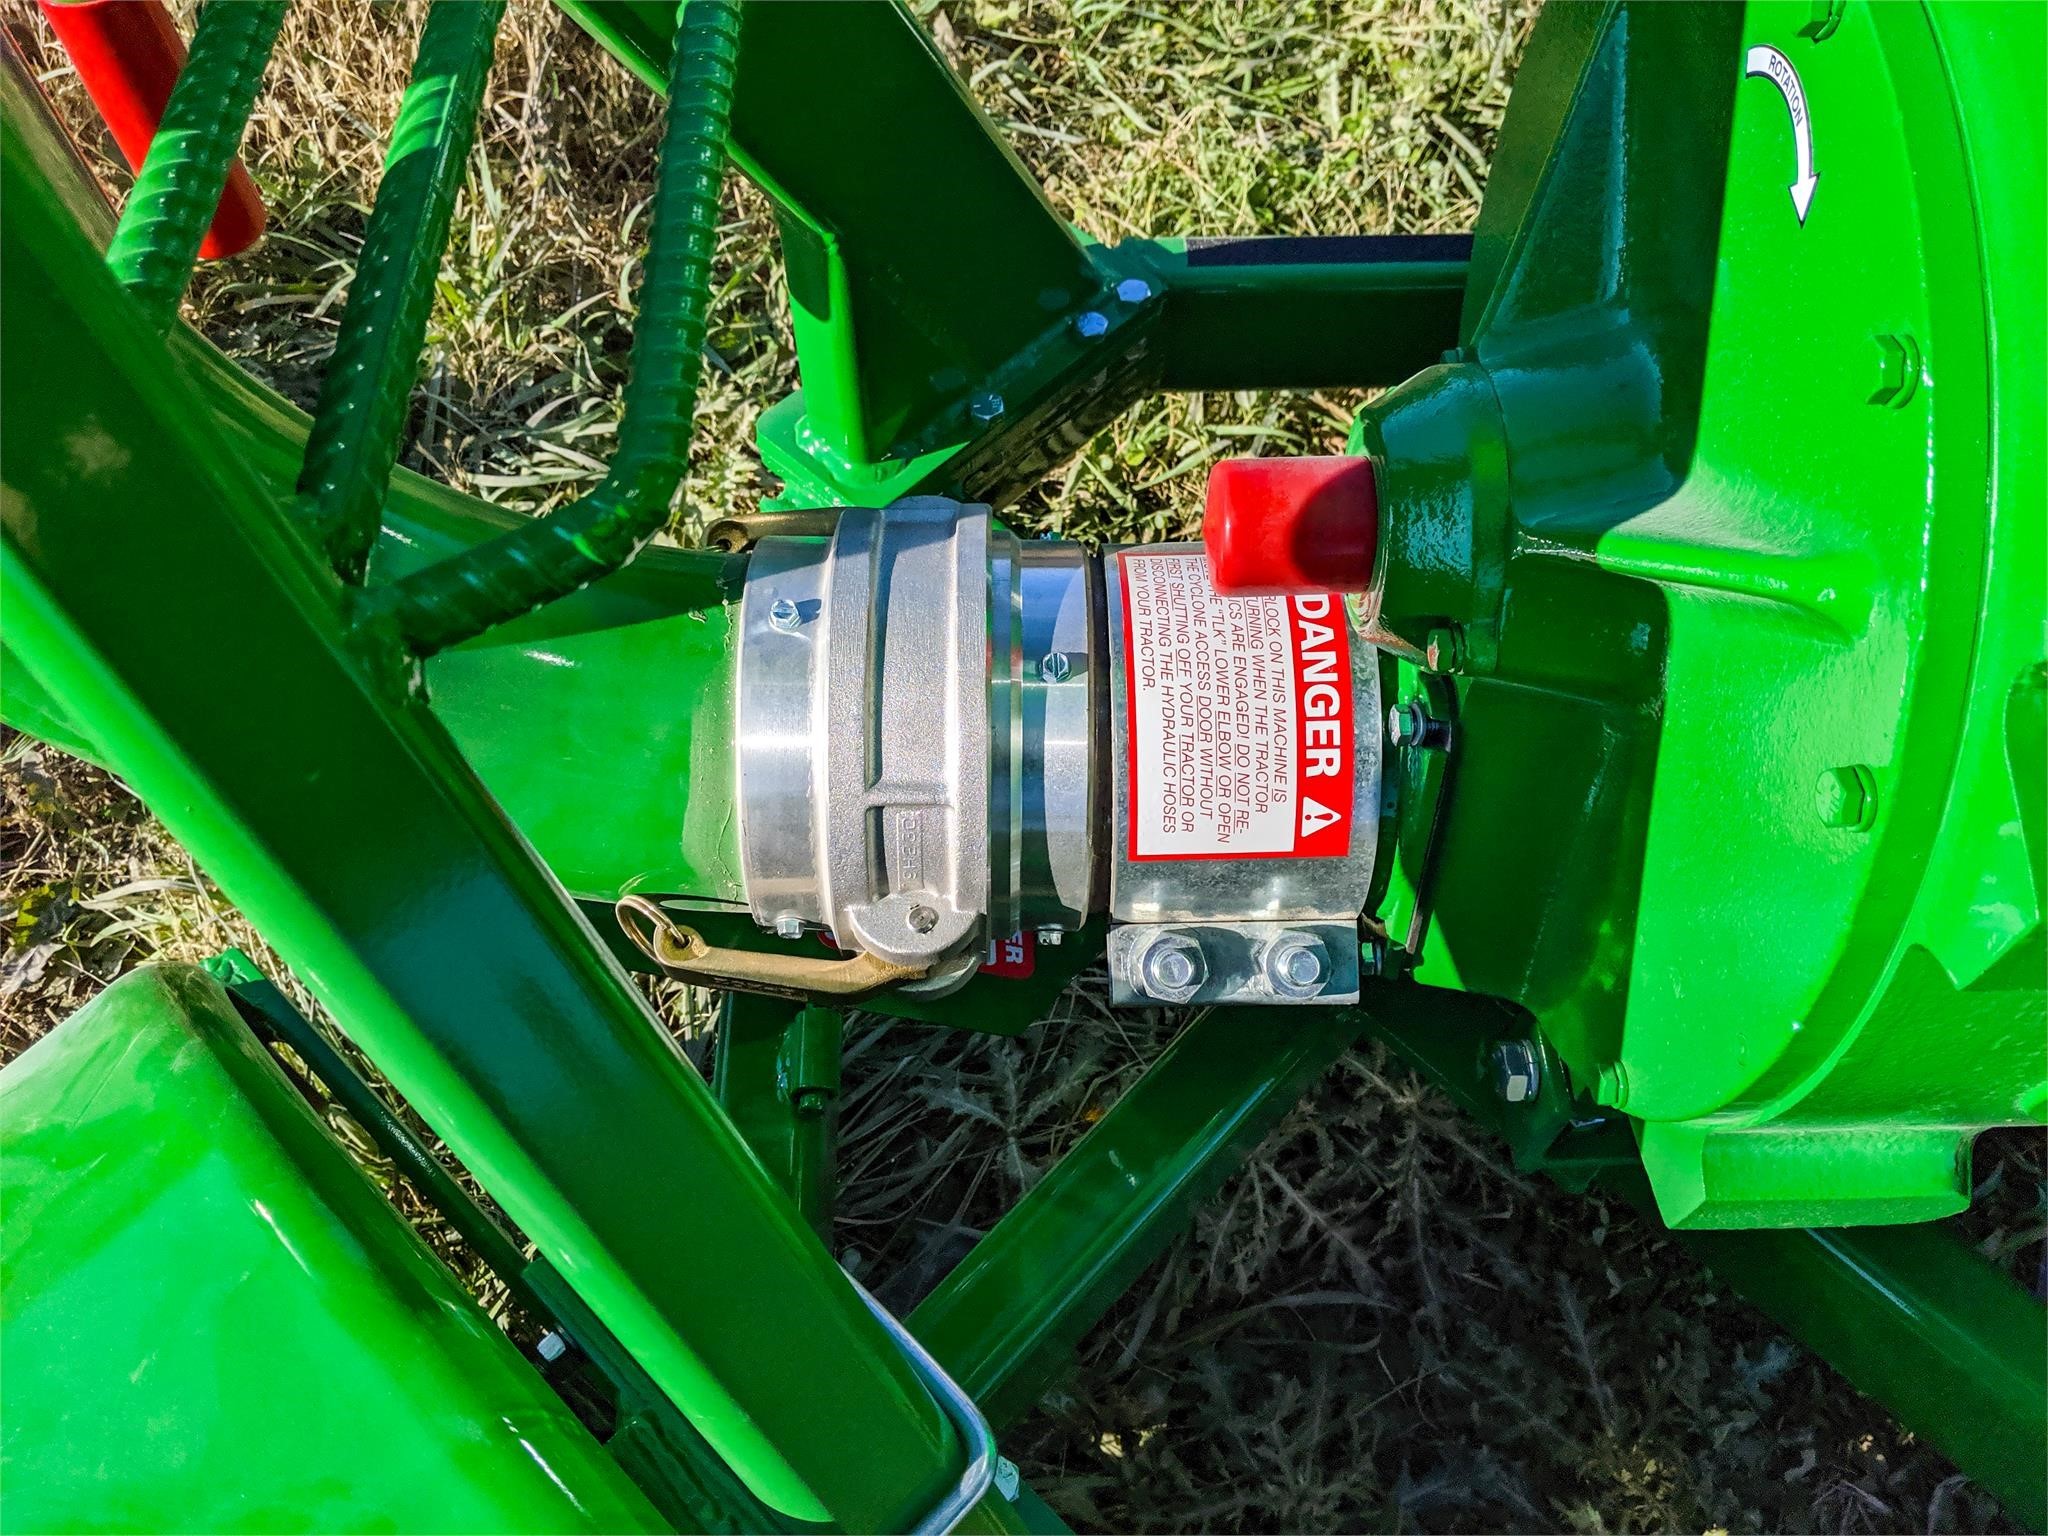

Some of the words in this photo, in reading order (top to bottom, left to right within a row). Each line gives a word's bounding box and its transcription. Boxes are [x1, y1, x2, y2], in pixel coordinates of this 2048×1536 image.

[1768, 54, 1803, 127] ROTATION
[1133, 559, 1147, 582] FROM
[1168, 558, 1183, 581] FIRST
[1186, 557, 1200, 572] THE
[1137, 584, 1151, 617] YOUR
[1151, 558, 1172, 647] DISCONNECTING
[1172, 582, 1190, 644] SHUTTING
[1188, 573, 1207, 628] CYCLONE
[1208, 585, 1222, 605] HE
[1140, 620, 1155, 691] TRACTOR.
[1231, 623, 1245, 652] ARE
[1269, 641, 1283, 664] ON
[1160, 652, 1174, 681] THE
[1178, 648, 1192, 678] OFF
[1195, 630, 1211, 691] ACCESS
[1214, 649, 1230, 706] LOWER
[1252, 654, 1267, 701] WHEN
[1180, 683, 1193, 728] YOUR
[1233, 656, 1250, 739] ENGAGED!
[1272, 668, 1286, 703] THIS
[1294, 594, 1341, 777] DANGER
[1161, 685, 1176, 777] HYDRAULIC
[1198, 695, 1213, 743] DOOR
[1217, 710, 1231, 771] ELBOW
[1255, 705, 1268, 736] THE
[1236, 743, 1250, 768] DO
[1273, 708, 1287, 785] MACHINE
[1181, 732, 1195, 807] TRACTOR
[1200, 748, 1213, 820] WITHOUT
[1218, 775, 1231, 798] OR
[1237, 772, 1250, 806] NOT
[1255, 741, 1269, 813] TRACTOR
[1163, 782, 1176, 833] HOSES
[1273, 788, 1287, 803] IS
[1181, 811, 1194, 832] OR
[1217, 803, 1231, 843] OPEN
[1236, 809, 1249, 834] RE-
